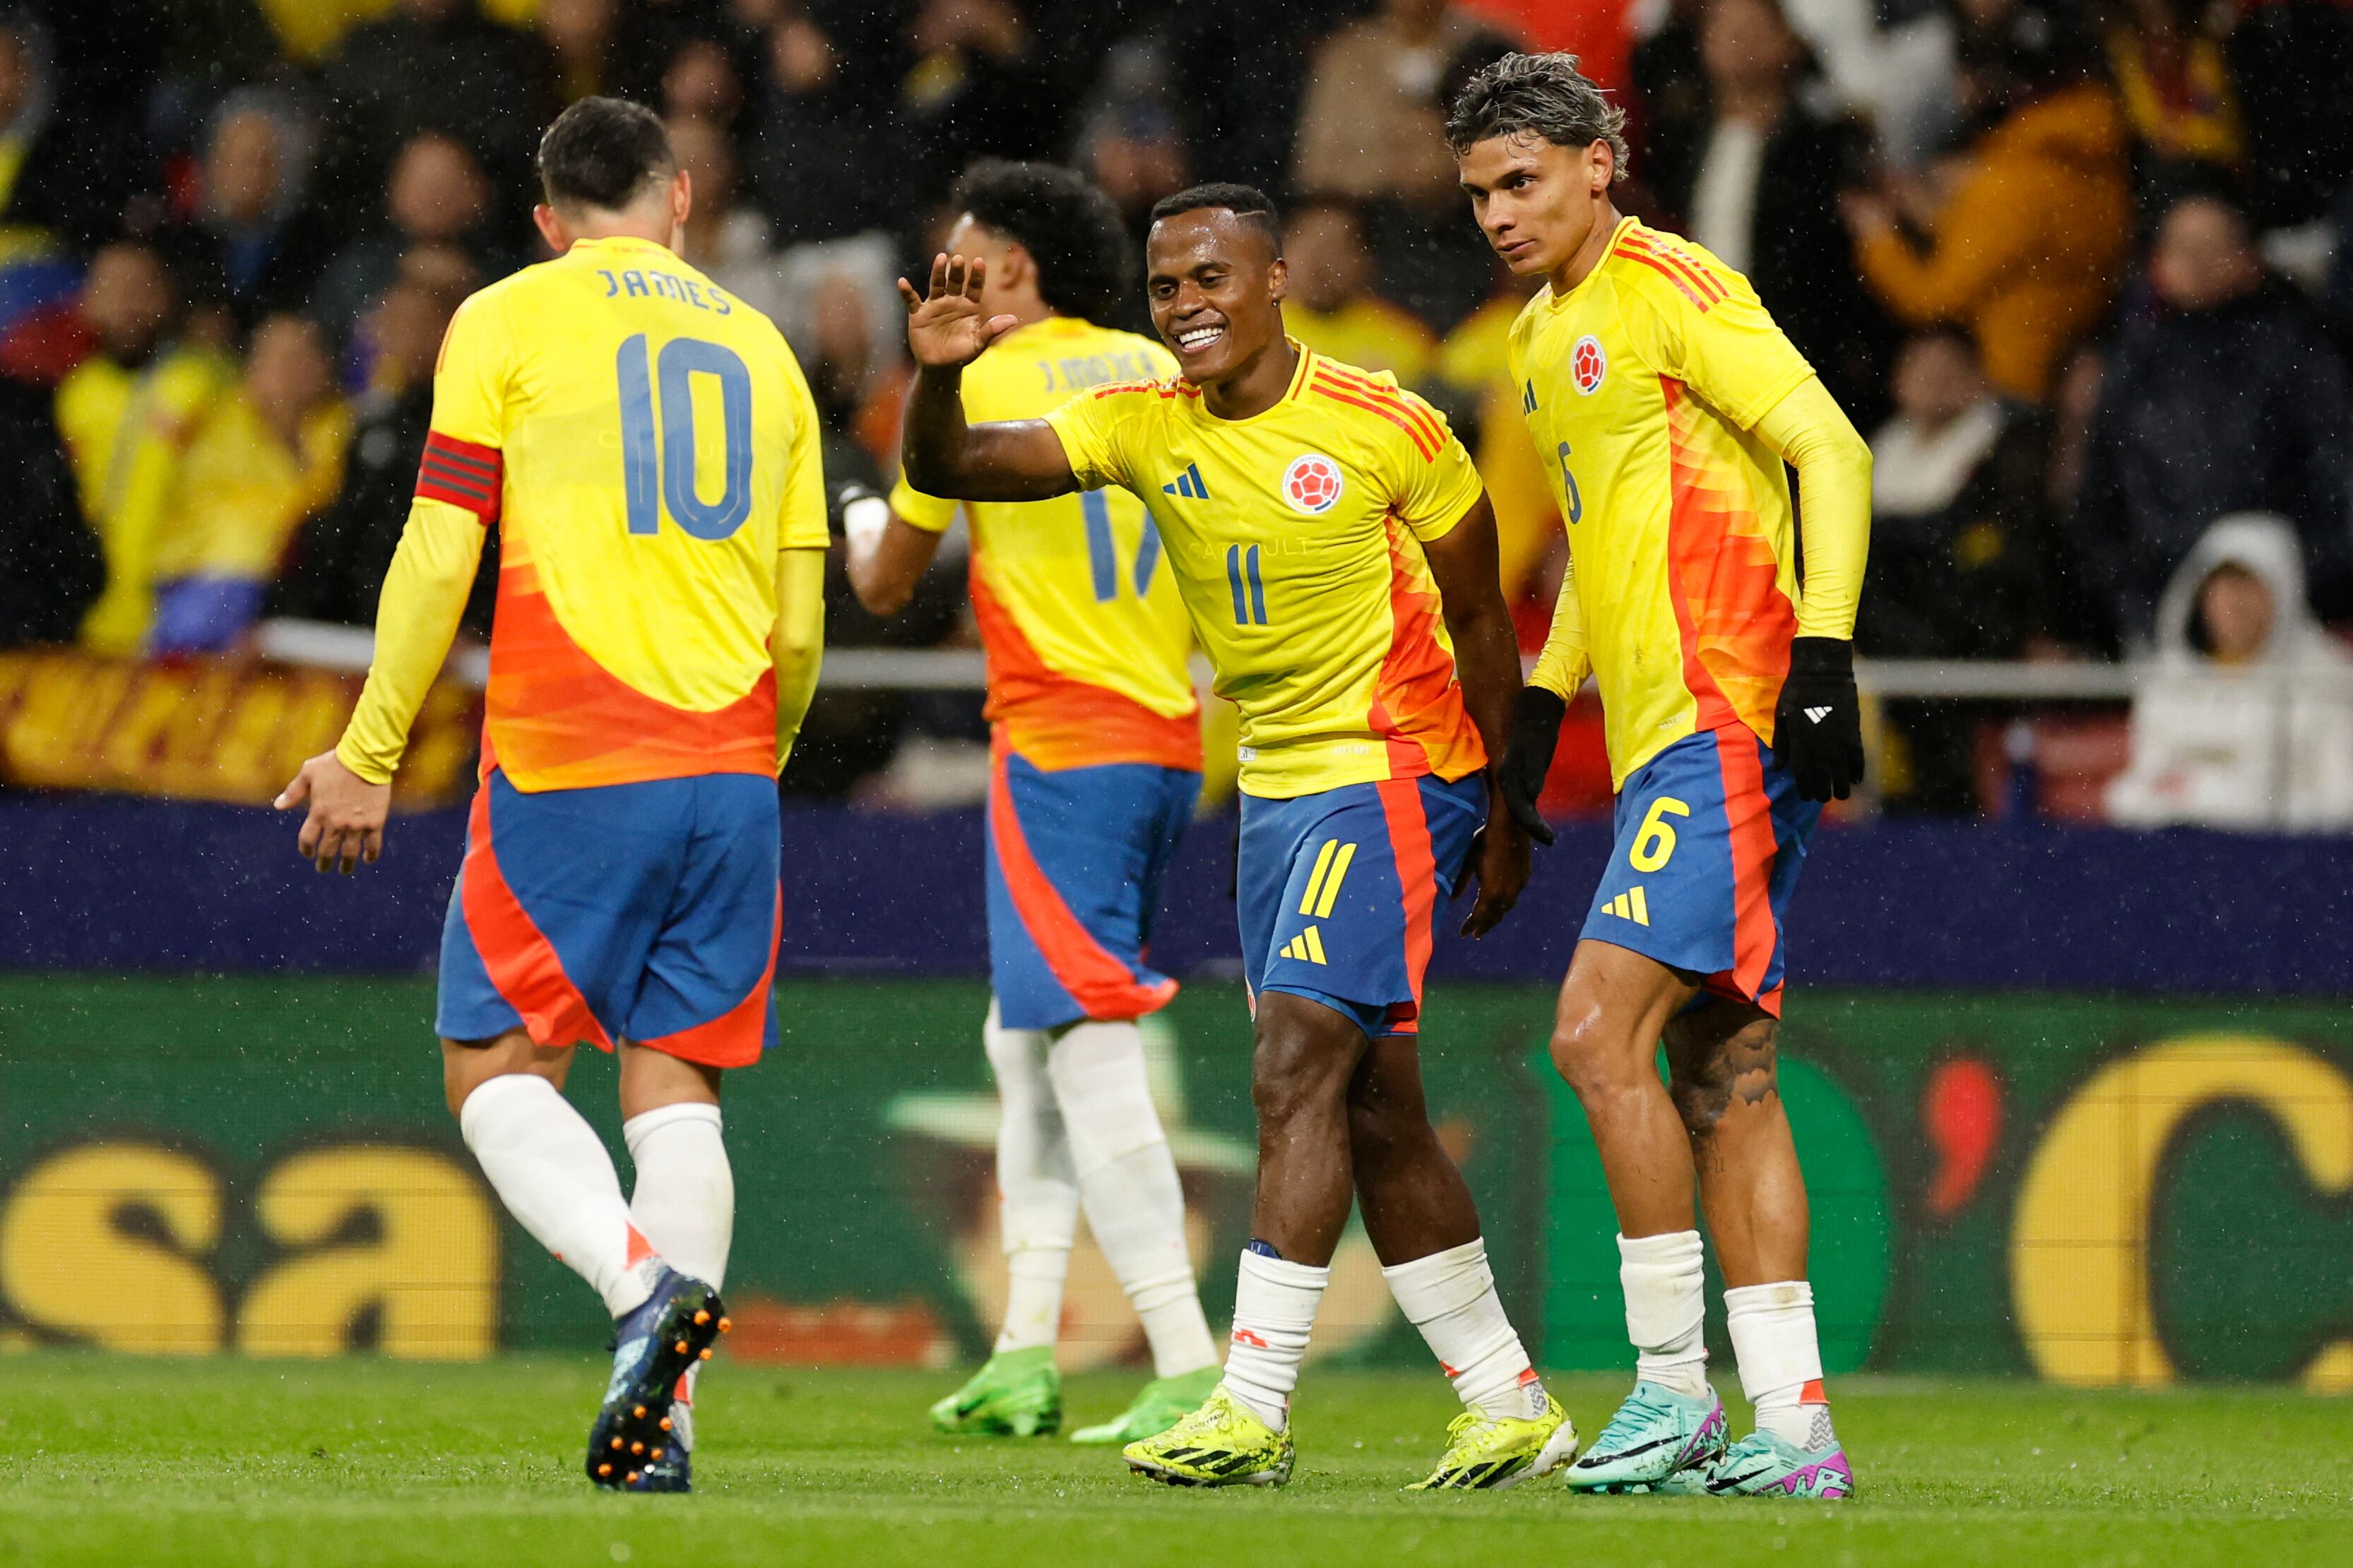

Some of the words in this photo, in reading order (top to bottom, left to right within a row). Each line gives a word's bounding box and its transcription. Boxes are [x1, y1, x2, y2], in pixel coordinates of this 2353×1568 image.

[597, 270, 732, 316] JAMES
[616, 333, 753, 541] 10
[1558, 441, 1582, 525] 6
[1227, 543, 1268, 625] 11
[1629, 796, 1690, 872] 6
[1298, 838, 1357, 918] 11
